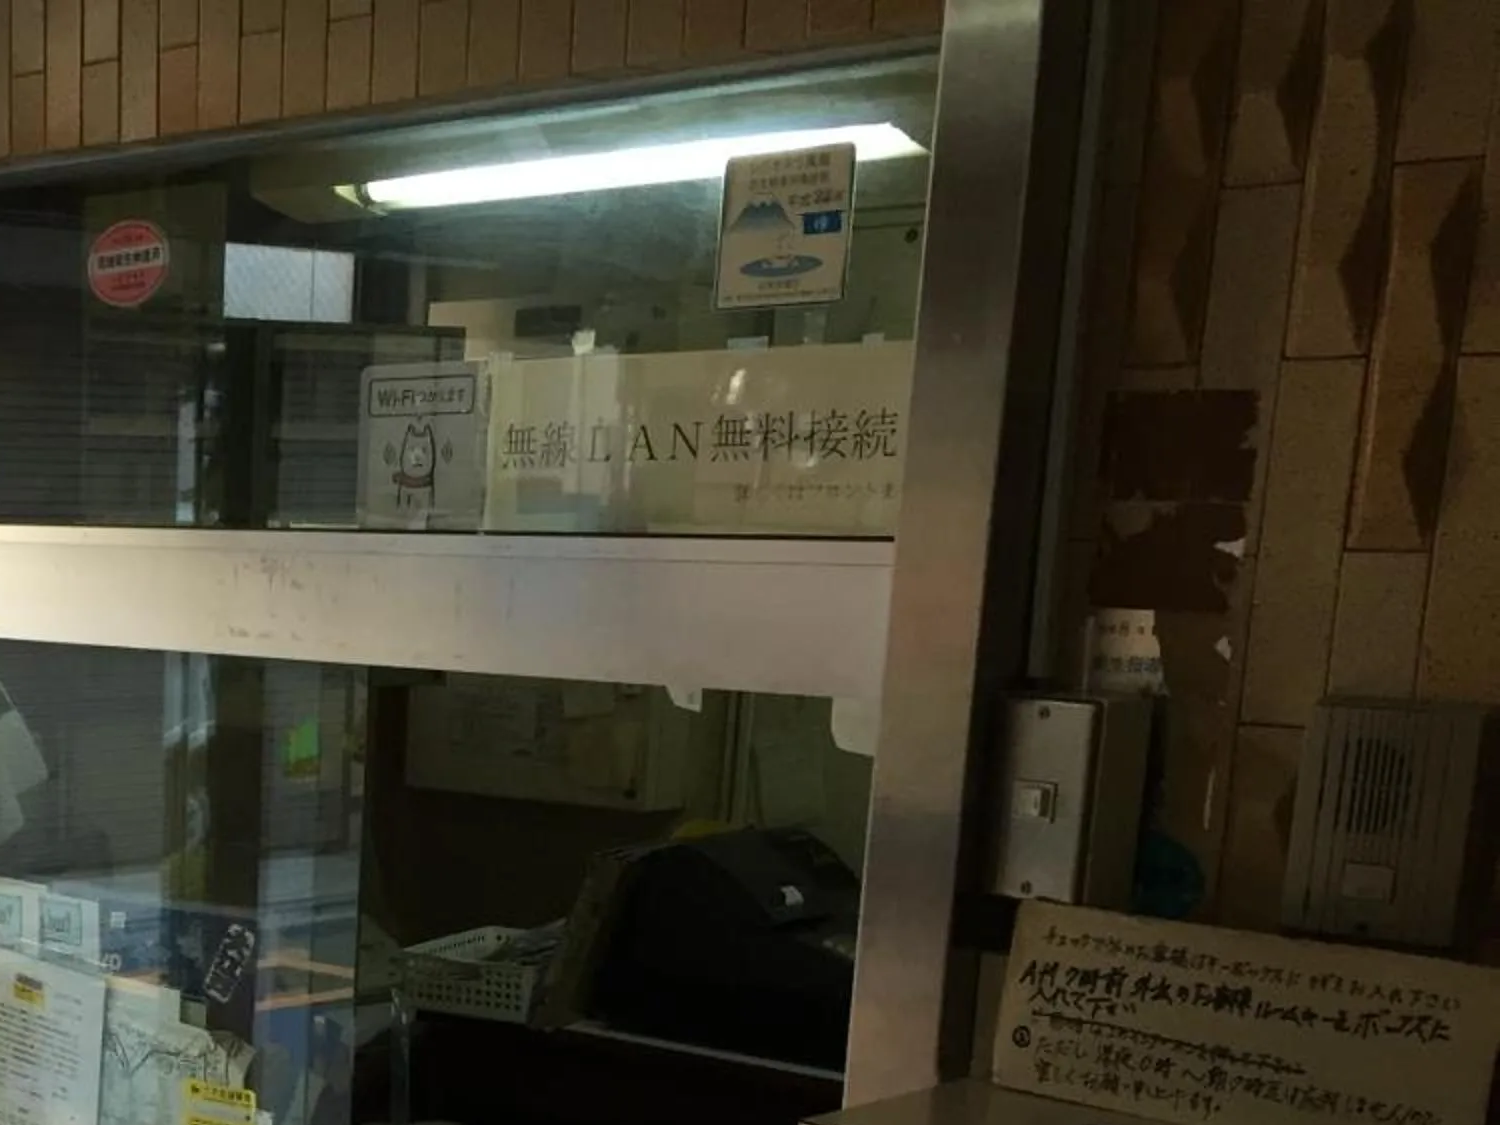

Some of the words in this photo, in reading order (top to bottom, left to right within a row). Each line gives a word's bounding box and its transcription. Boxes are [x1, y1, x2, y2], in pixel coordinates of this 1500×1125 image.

[502, 407, 898, 469] 無線LAN無料接続
